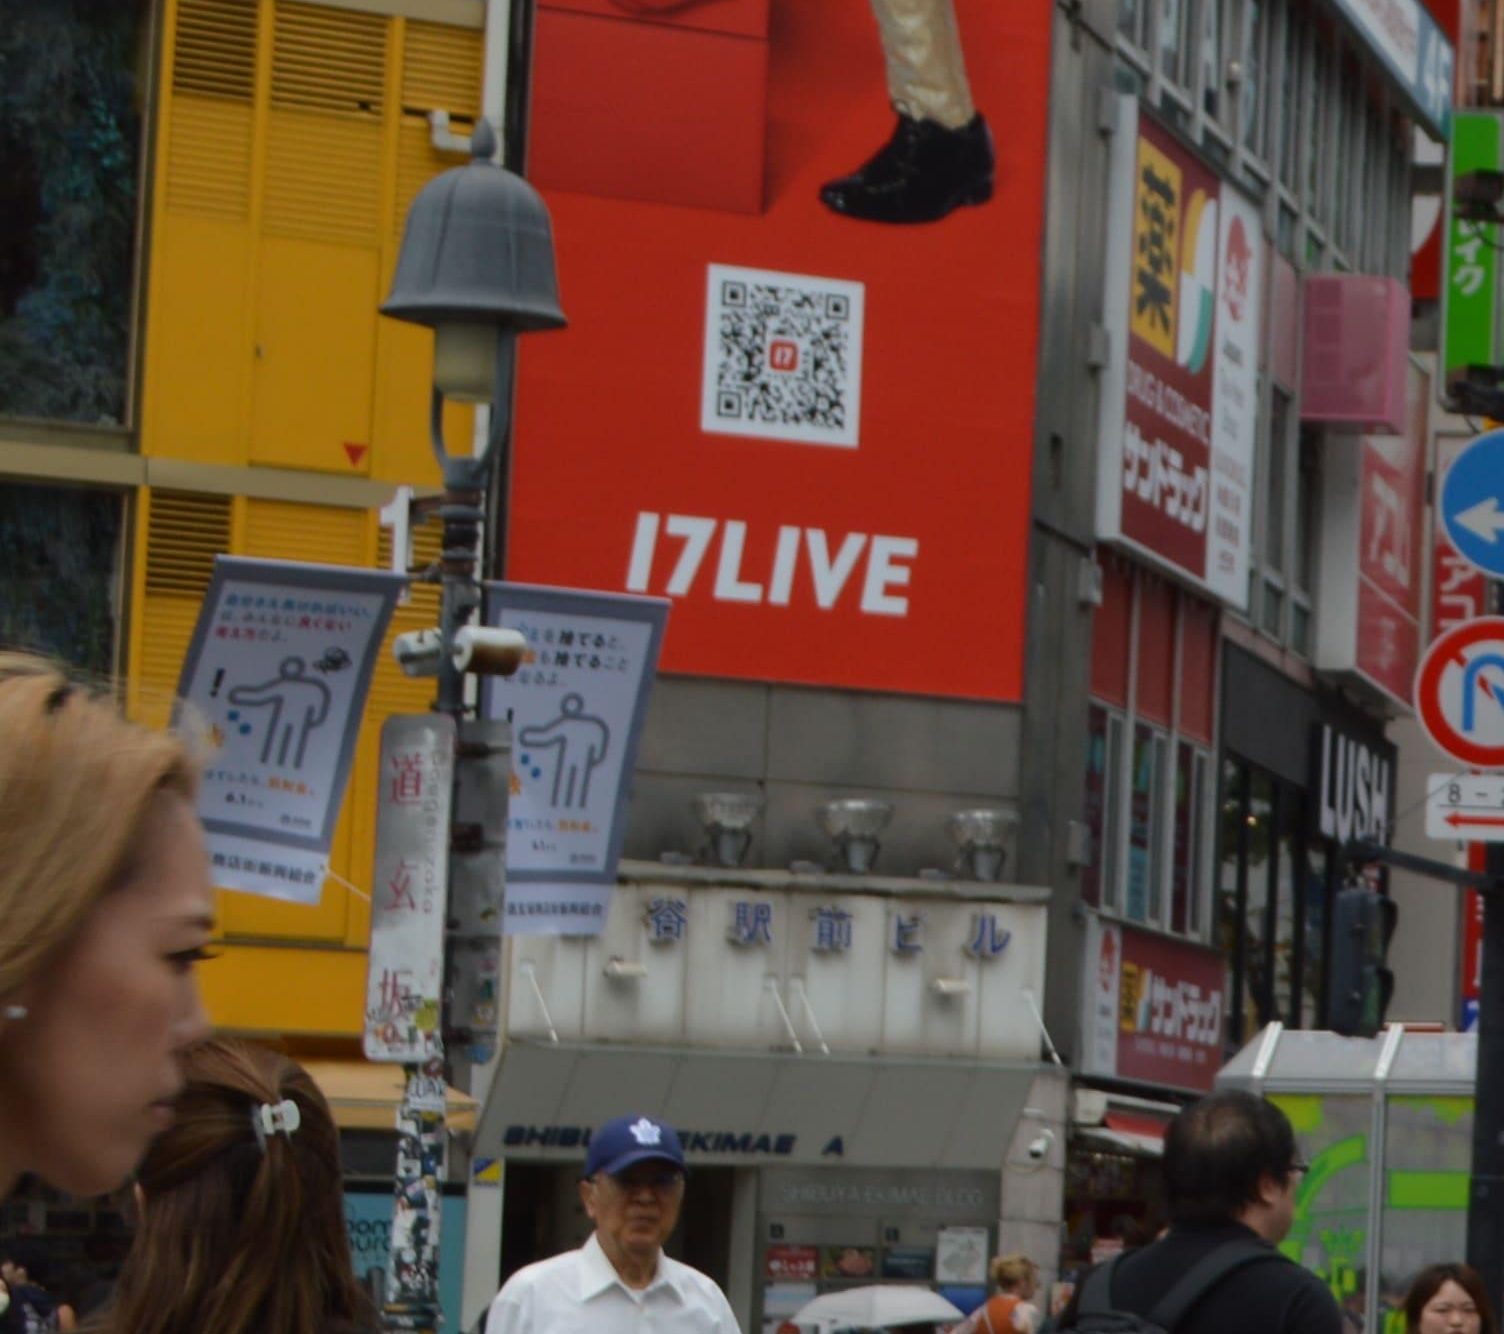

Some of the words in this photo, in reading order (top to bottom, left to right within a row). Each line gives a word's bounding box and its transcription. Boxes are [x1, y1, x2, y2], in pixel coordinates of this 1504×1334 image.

[1124, 419, 1209, 535] サンドラッグ
[1320, 724, 1390, 845] LUSH
[1447, 783, 1461, 804] 8
[1151, 975, 1222, 1047] サンドラッグ
[822, 1135, 846, 1157] A
